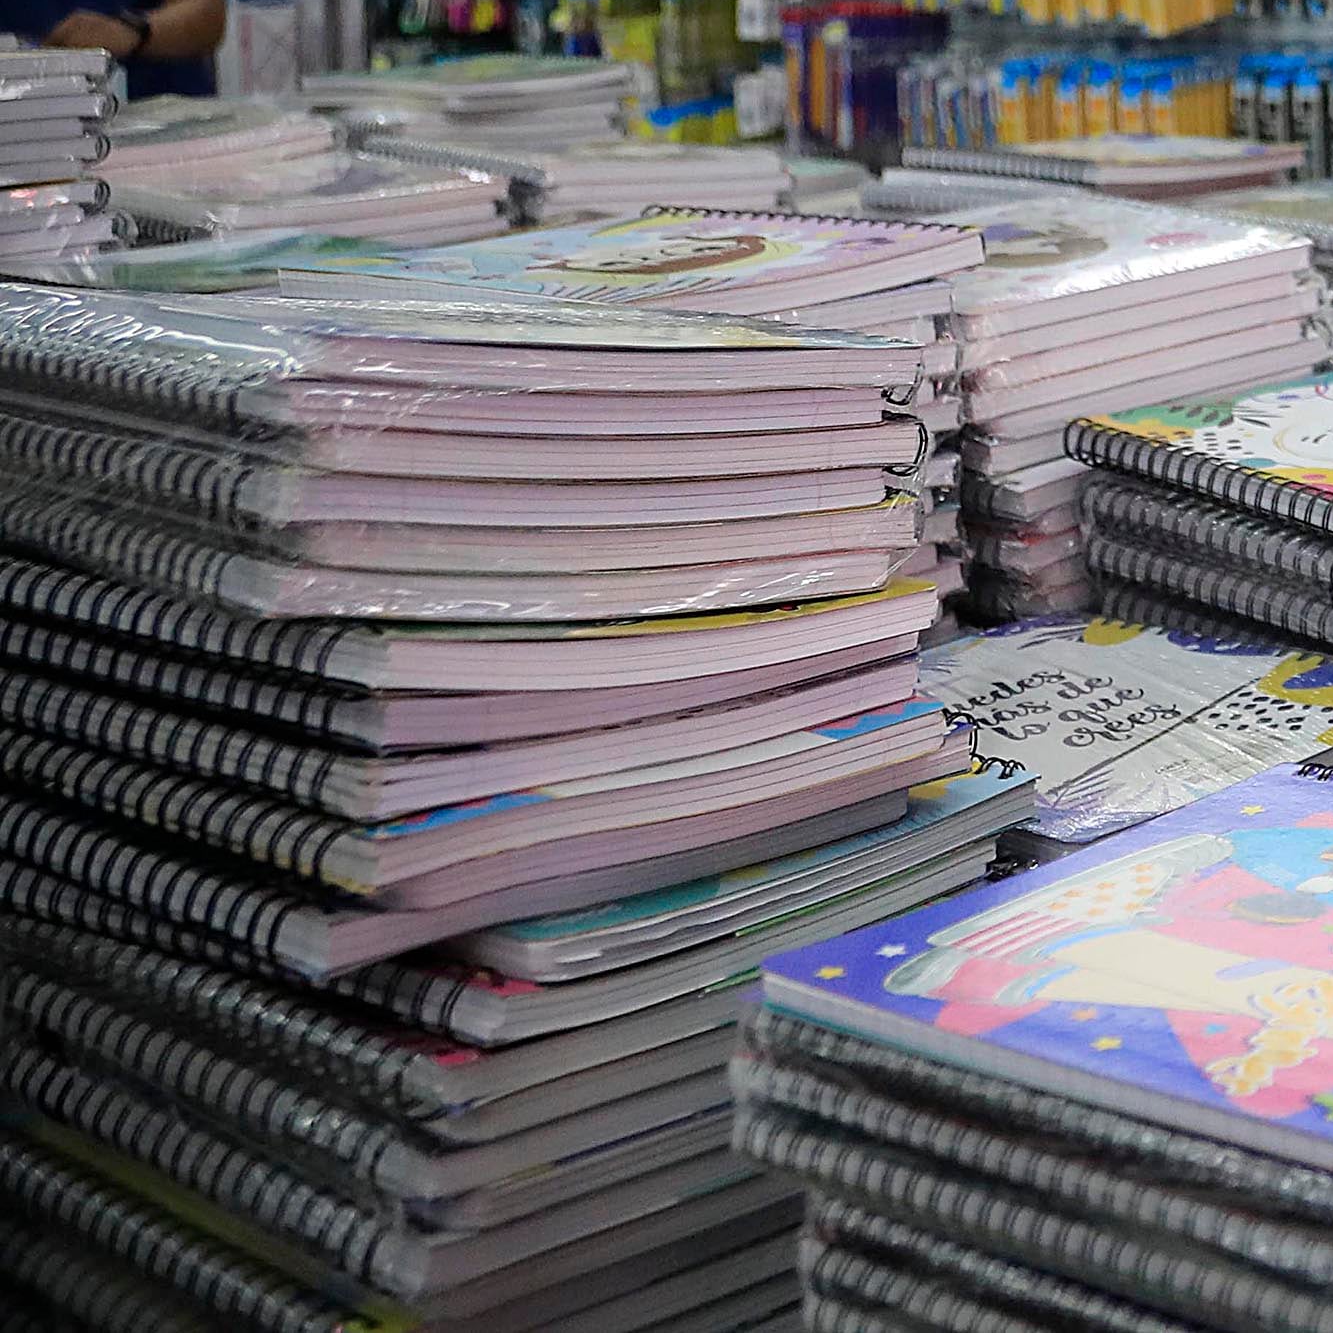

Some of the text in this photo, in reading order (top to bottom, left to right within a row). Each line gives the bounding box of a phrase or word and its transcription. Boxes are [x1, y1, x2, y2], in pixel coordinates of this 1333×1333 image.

[944, 669, 1065, 713] uedes
[1057, 676, 1112, 699] de
[1058, 688, 1144, 724] que
[1063, 704, 1181, 747] crees
